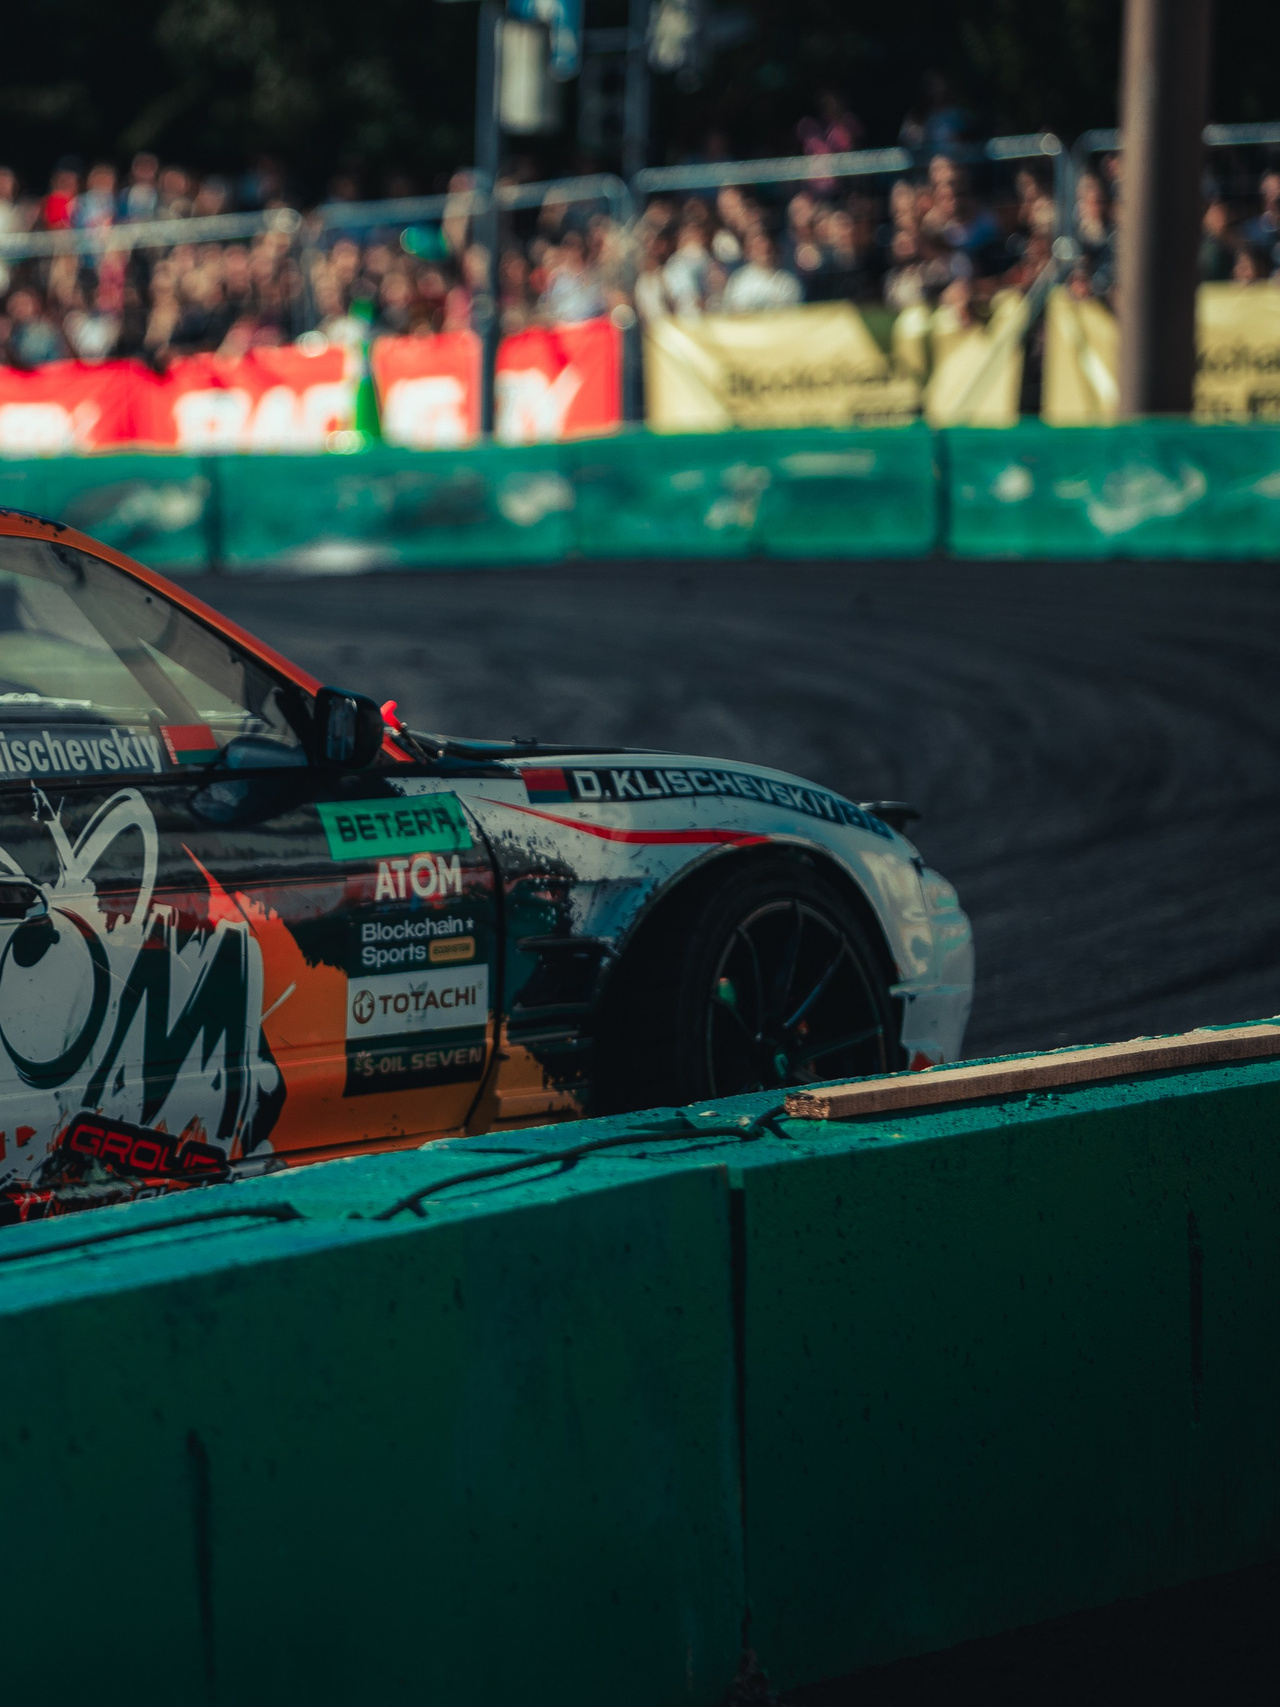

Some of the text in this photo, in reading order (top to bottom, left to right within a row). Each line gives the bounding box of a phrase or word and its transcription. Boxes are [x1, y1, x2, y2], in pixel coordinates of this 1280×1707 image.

[374, 854, 463, 901] ATOM
[361, 915, 464, 943] Blockchain
[361, 943, 427, 968] Sports
[378, 985, 477, 1016] TOTACHI
[411, 1046, 483, 1071] SEVEN
